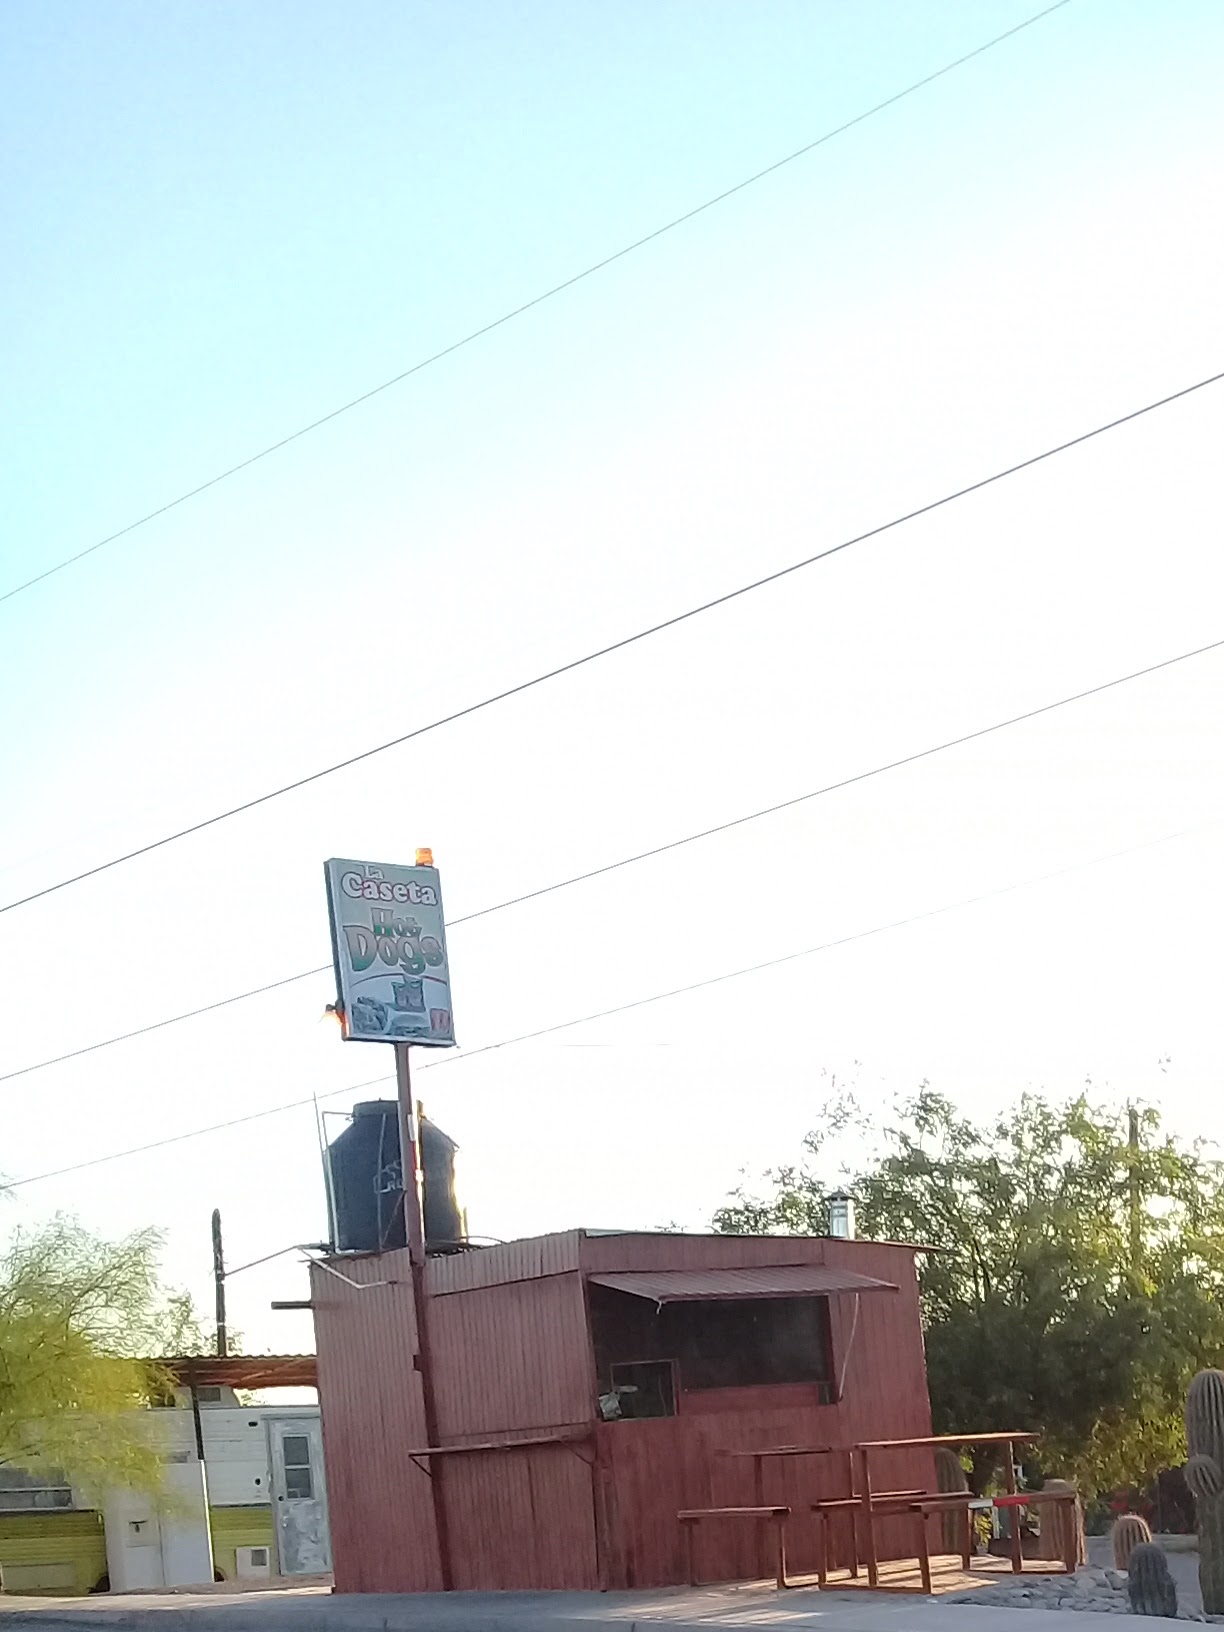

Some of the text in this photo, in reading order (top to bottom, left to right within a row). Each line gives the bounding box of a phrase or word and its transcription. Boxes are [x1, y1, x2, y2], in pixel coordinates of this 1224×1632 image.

[362, 864, 384, 880] La
[341, 871, 438, 906] Caseta
[370, 907, 421, 937] Hot
[342, 925, 444, 975] Dogs
